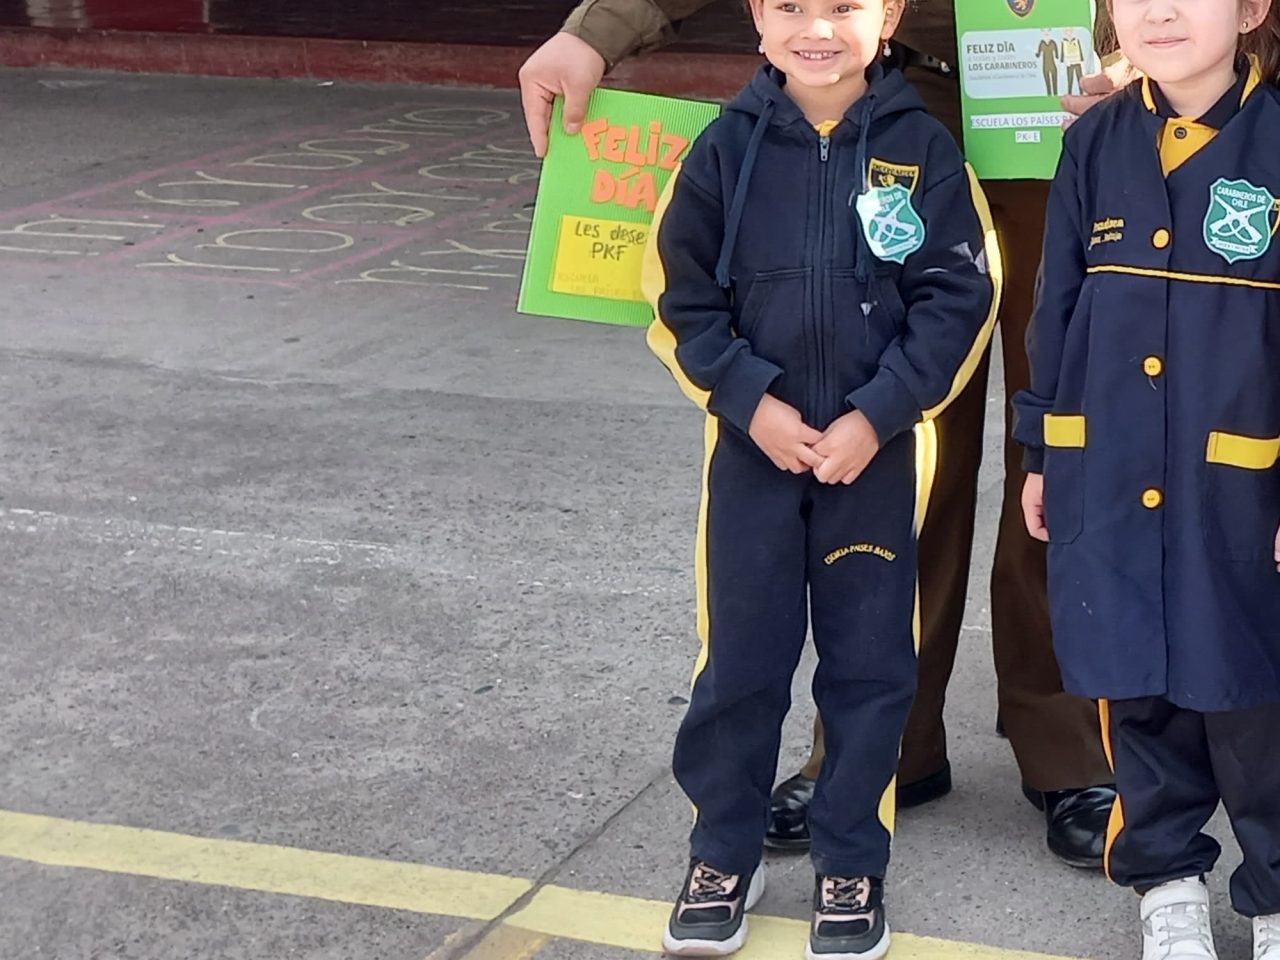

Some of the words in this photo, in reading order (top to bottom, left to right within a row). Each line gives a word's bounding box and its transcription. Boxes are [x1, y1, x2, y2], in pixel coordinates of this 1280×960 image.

[966, 43, 995, 54] FELIZ
[968, 63, 984, 71] LOS
[984, 61, 1037, 71] CARABINEROS
[971, 117, 1010, 128] ESCUELA
[1012, 117, 1027, 127] LOS
[1030, 114, 1060, 126] PAÍSES
[591, 165, 659, 214] DÍA
[575, 220, 601, 239] Les
[610, 224, 649, 245] dese
[591, 241, 629, 262] PKF
